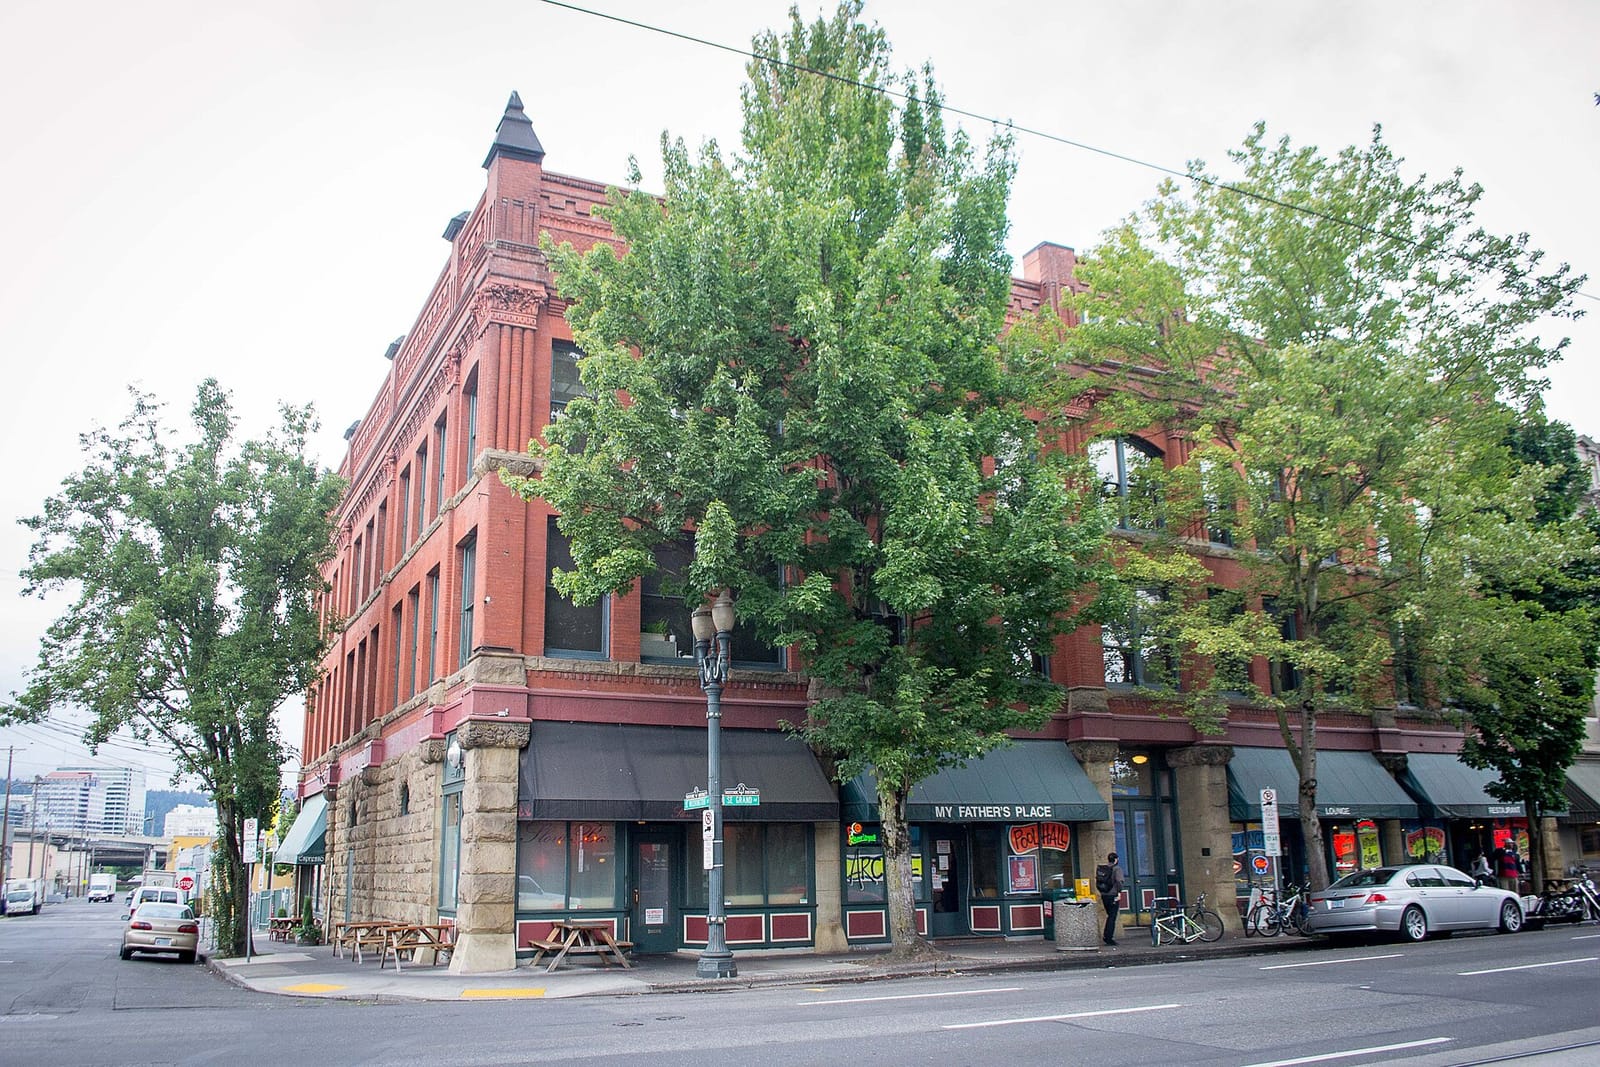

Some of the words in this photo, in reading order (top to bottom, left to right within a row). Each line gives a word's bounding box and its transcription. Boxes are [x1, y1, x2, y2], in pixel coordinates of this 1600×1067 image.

[726, 795, 733, 804] SE
[735, 795, 753, 804] GRAND
[935, 806, 953, 818] MY
[958, 806, 1011, 818] FATHER'S
[1015, 806, 1052, 818] PLACE
[1325, 807, 1351, 815] LOUNGE
[1488, 806, 1521, 814] RESTAURANT
[1042, 823, 1067, 847] HALL
